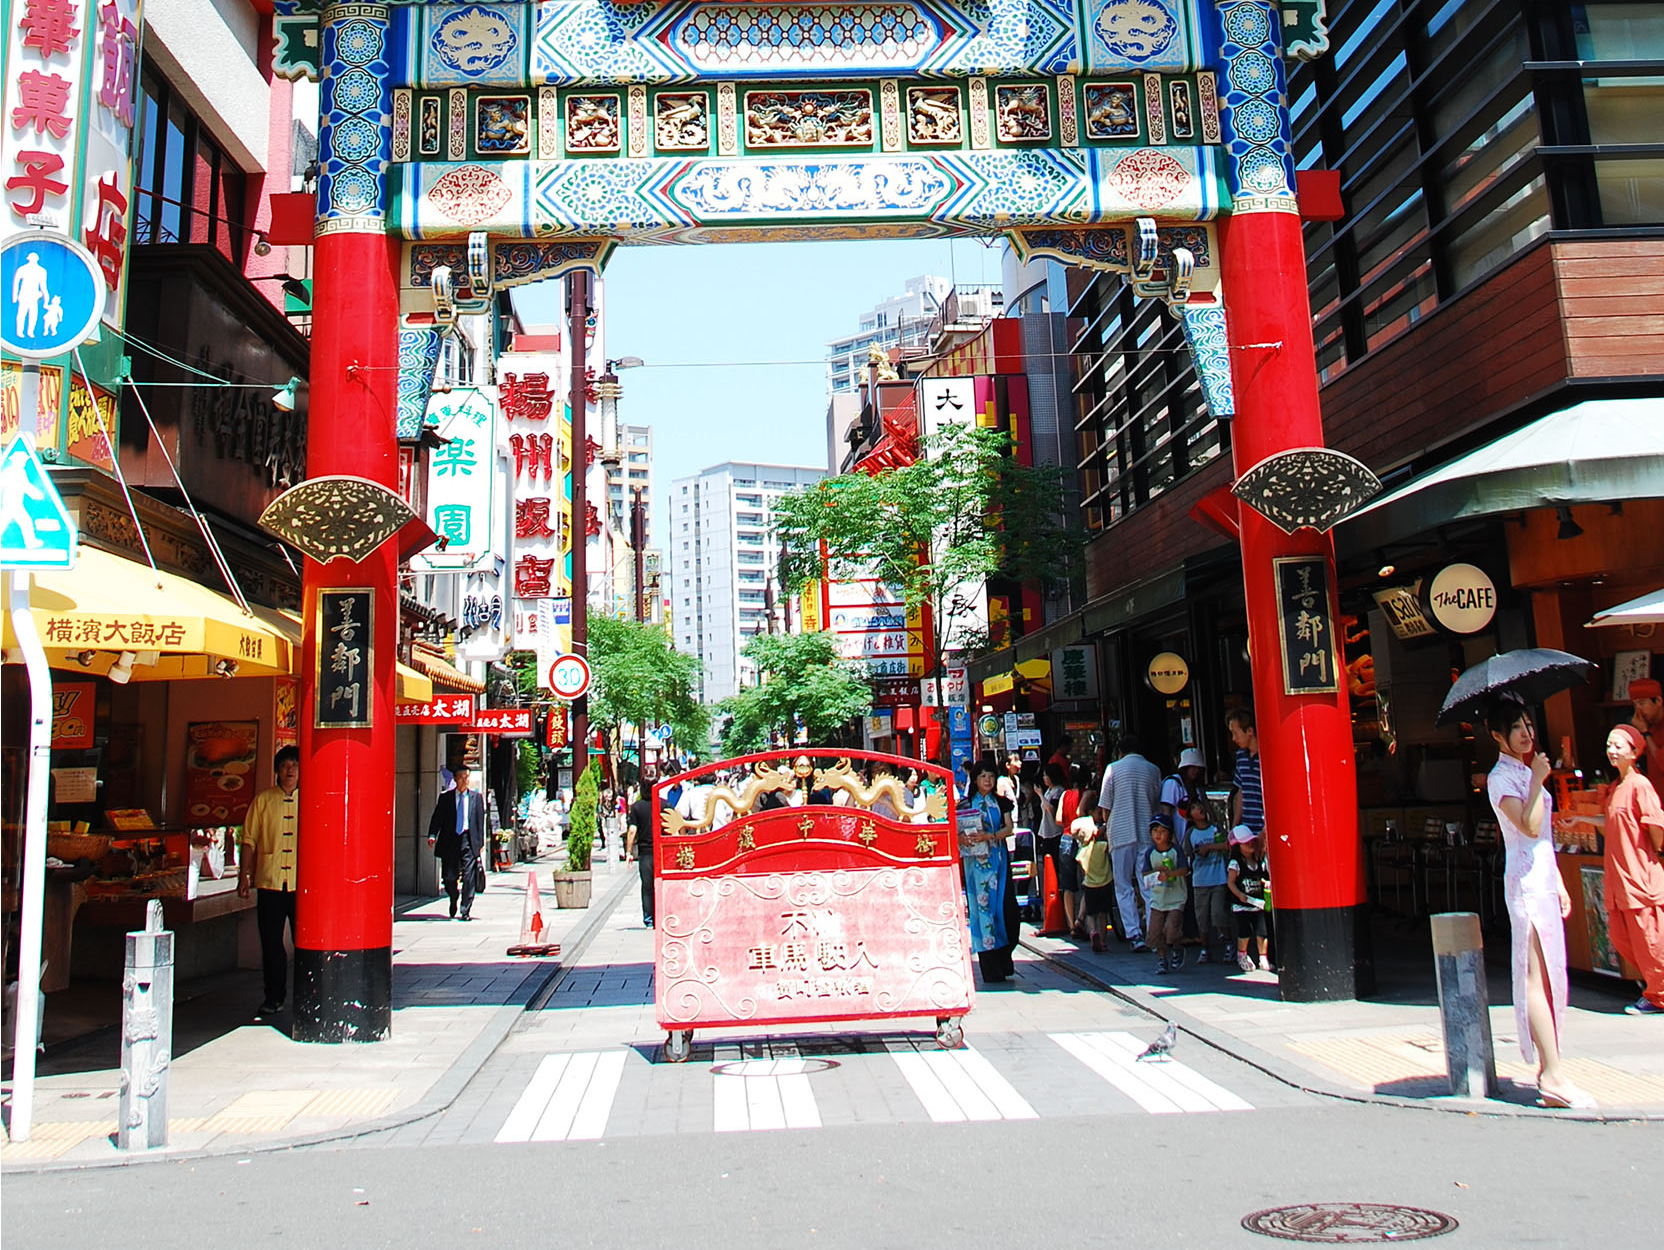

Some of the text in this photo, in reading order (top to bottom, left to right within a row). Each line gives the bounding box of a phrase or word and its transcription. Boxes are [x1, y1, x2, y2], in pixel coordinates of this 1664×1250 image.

[432, 435, 478, 546] 楽園
[1433, 587, 1493, 609] The CAFE
[46, 617, 187, 646] 横濱大飯店
[558, 667, 581, 686] 30
[927, 681, 965, 694] おやげ
[432, 699, 470, 718] 太湖
[499, 713, 530, 729] 太湖
